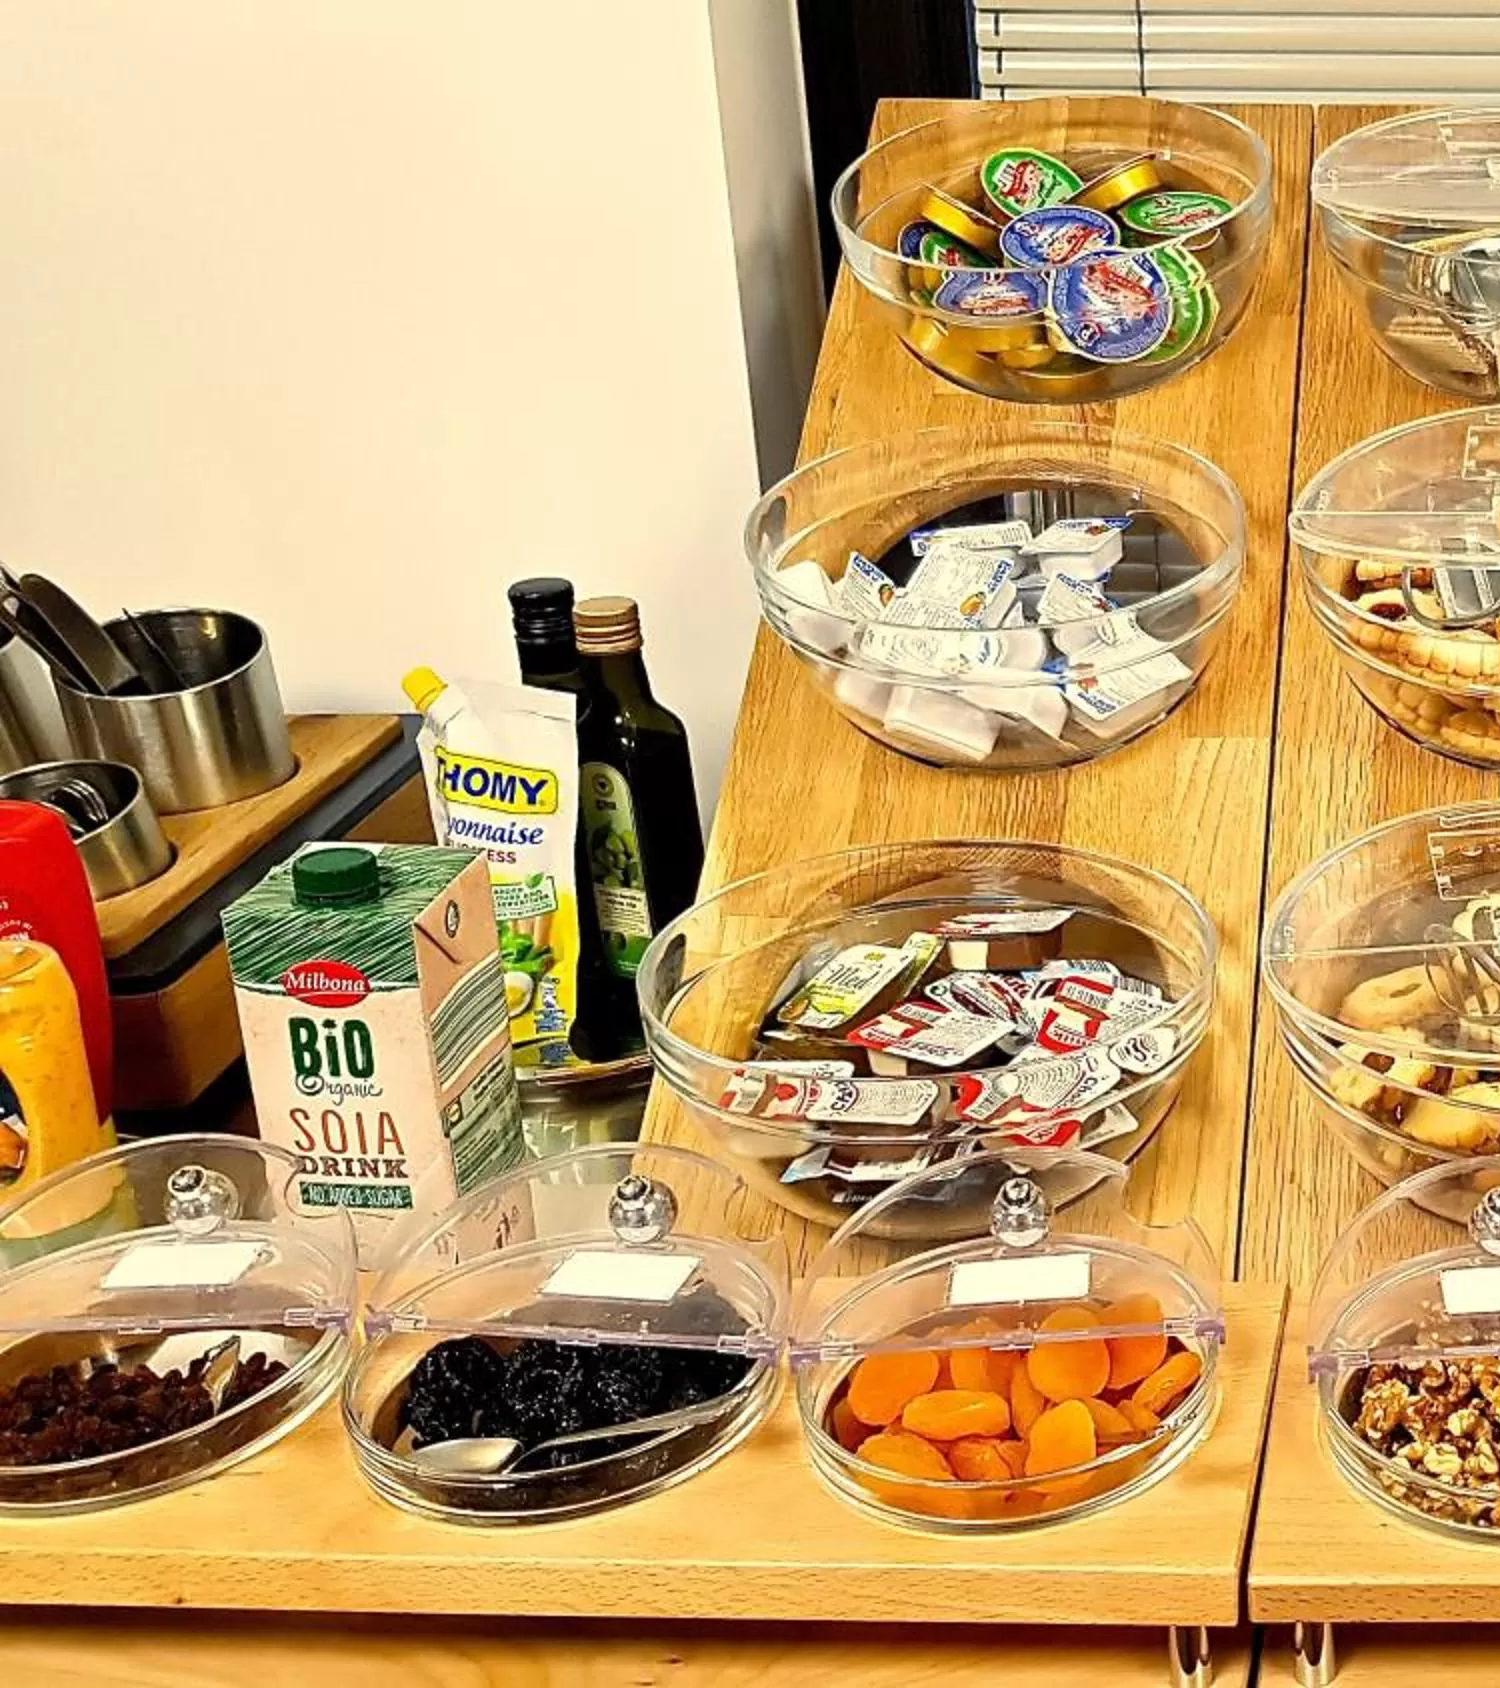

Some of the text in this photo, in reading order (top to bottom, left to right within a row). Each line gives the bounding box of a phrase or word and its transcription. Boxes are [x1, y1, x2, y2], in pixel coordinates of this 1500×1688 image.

[284, 971, 366, 992] Milbona
[289, 1107, 405, 1156] SOIA
[298, 1155, 409, 1178] DRINK
